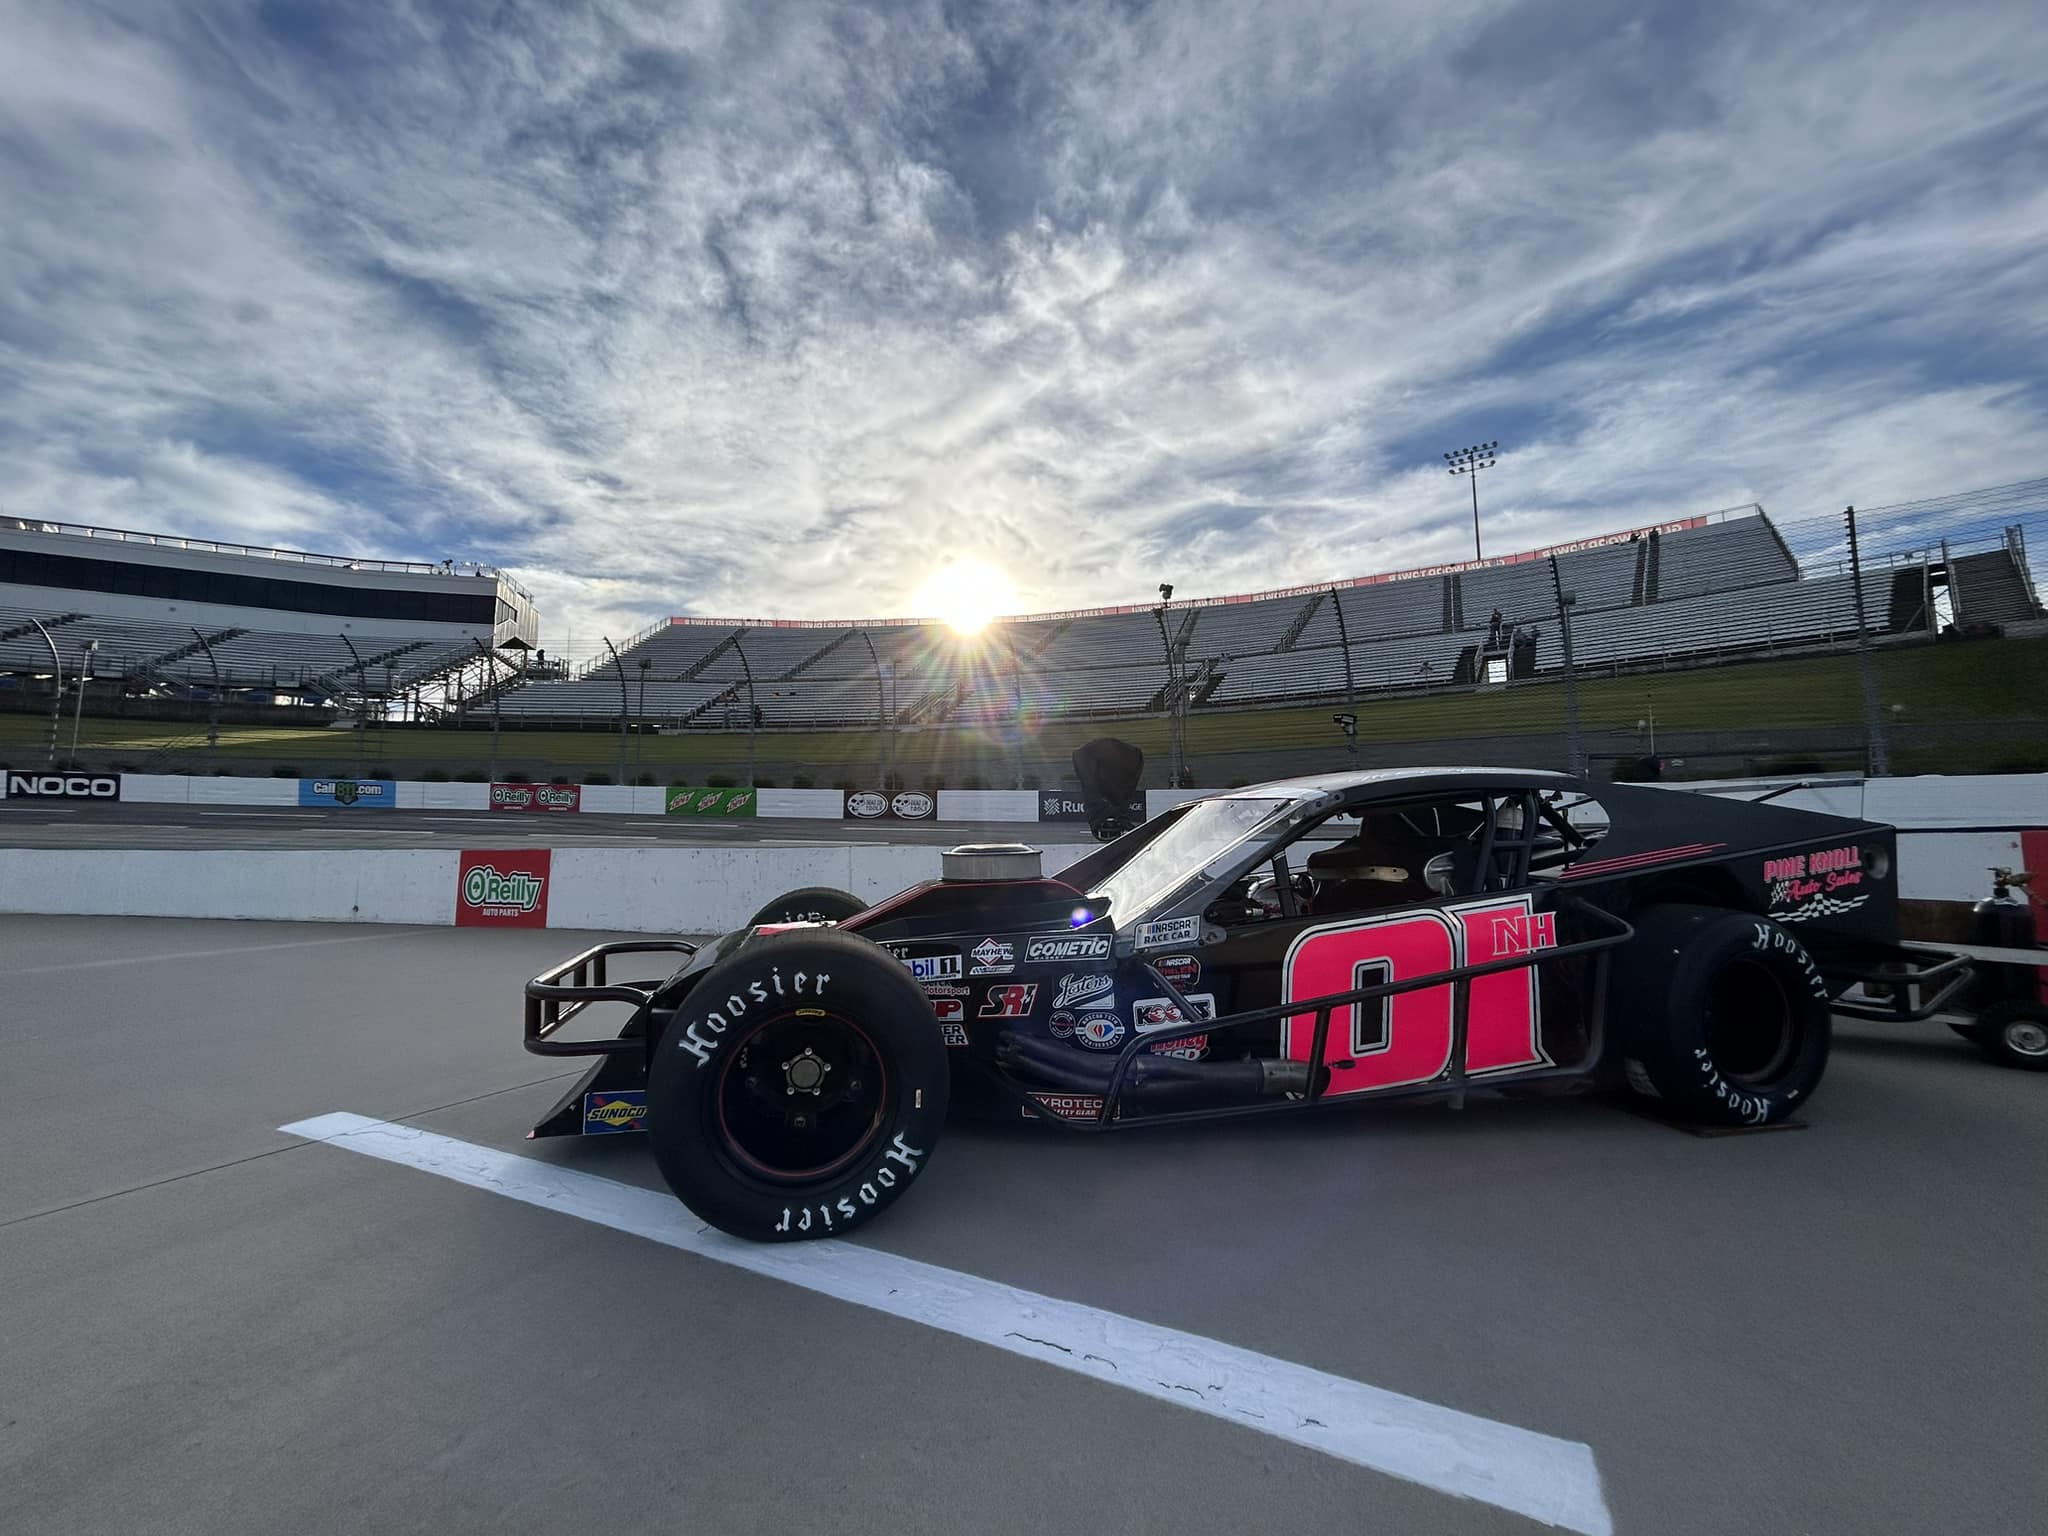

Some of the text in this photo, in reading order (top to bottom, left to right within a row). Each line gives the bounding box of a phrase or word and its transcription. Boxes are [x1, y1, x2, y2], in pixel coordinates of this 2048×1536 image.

[10, 776, 116, 796] NOCO
[1764, 845, 1861, 884] PINE KNOLL
[464, 866, 541, 910] O'Reilly
[482, 907, 519, 917] AUTO PARTS
[1155, 919, 1191, 933] NASCAR
[1491, 911, 1558, 956] NH
[1144, 930, 1190, 945] RACE CAR
[971, 948, 1013, 957] MAYHEW
[1029, 940, 1109, 957] COMETIC
[1166, 957, 1191, 967] NASCAR
[1752, 923, 1829, 998] Hoosier
[1053, 974, 1113, 1008] Jostens
[679, 967, 831, 1069] Hoosier
[1694, 1048, 1771, 1124] Hoosier
[1035, 1097, 1103, 1109] YROTEC
[590, 1107, 647, 1120] SUNOCO
[774, 1131, 924, 1232] Hoosier
